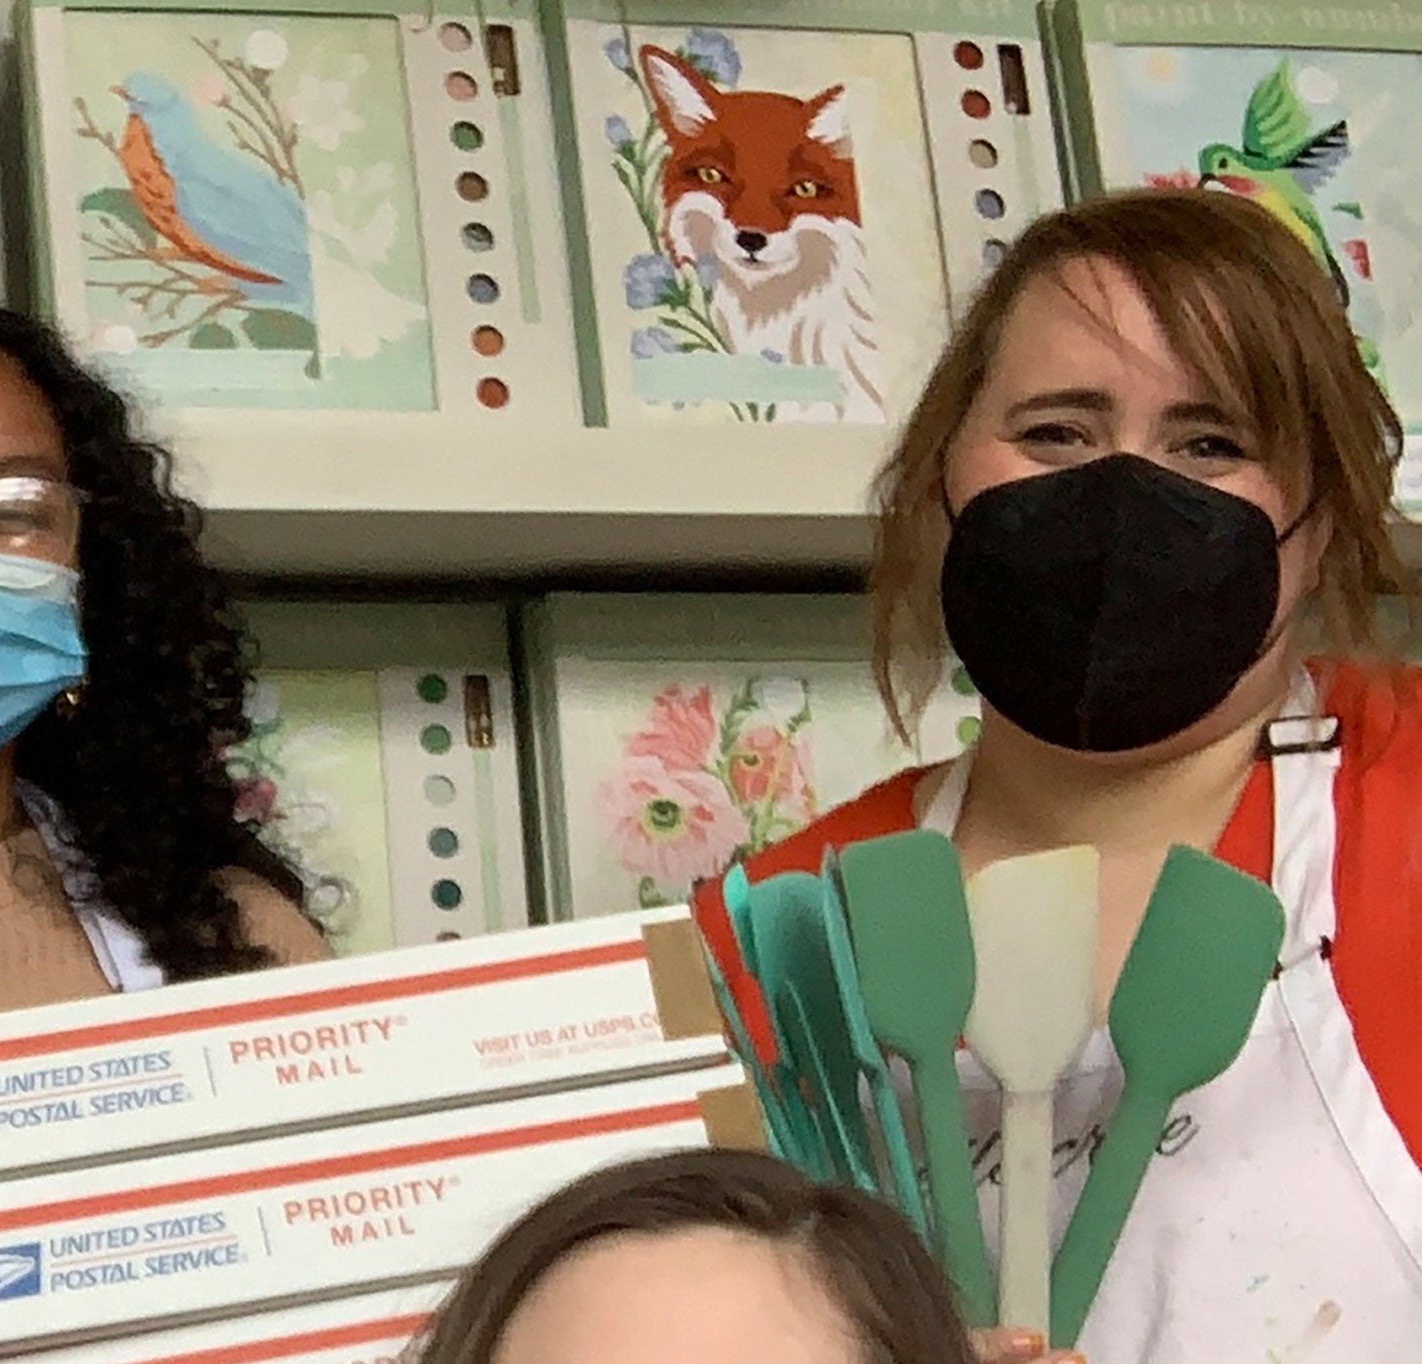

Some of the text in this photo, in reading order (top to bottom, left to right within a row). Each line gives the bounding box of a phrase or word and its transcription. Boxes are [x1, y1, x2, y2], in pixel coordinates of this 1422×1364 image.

[474, 1034, 521, 1056] VISIT
[526, 1029, 553, 1047] US
[558, 1024, 578, 1041] AT
[88, 1050, 173, 1083] STATES
[275, 1054, 363, 1085] MAIL
[49, 1211, 227, 1259] UNITED STATES
[329, 1215, 416, 1247] MAIL
[50, 1261, 140, 1293] POSTAL
